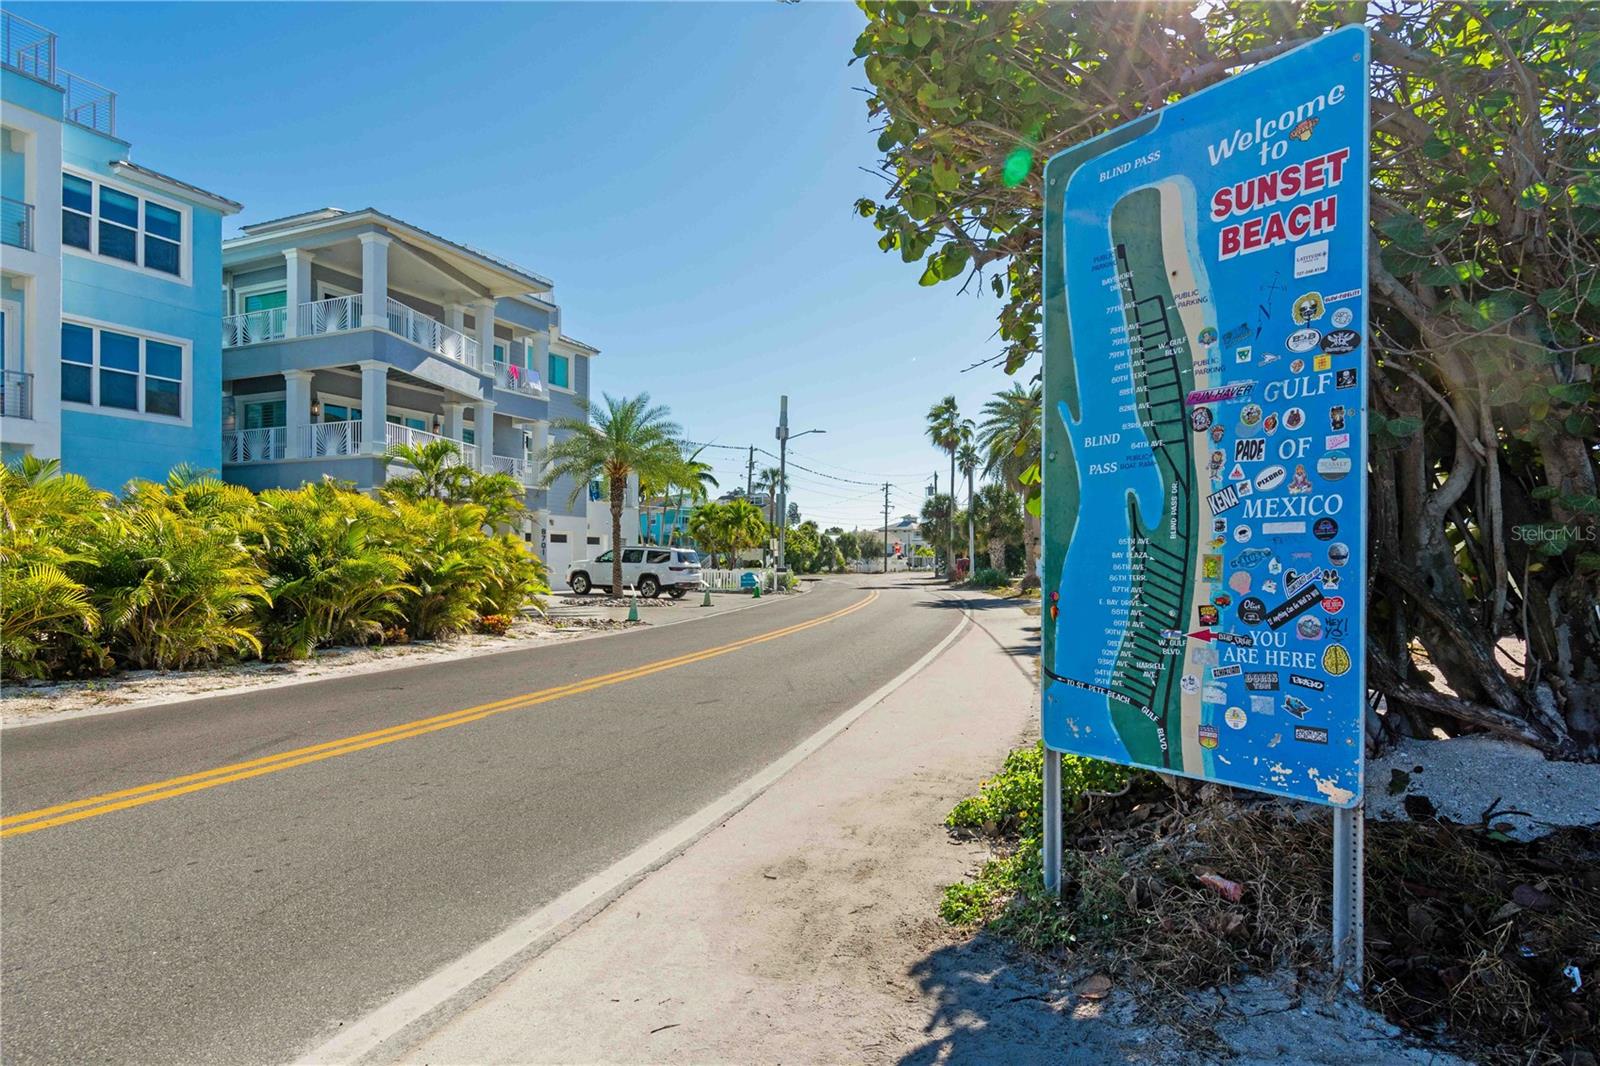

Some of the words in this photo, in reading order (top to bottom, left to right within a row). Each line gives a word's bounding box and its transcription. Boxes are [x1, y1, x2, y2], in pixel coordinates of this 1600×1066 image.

[1208, 84, 1345, 167] Welcome
[1258, 138, 1288, 166] to
[1099, 162, 1132, 183] BLIND
[1134, 150, 1161, 169] PASS
[1211, 148, 1350, 222] SUNSET
[1219, 195, 1337, 262] BEACH
[1174, 289, 1199, 300] PUBLIC
[1177, 296, 1208, 308] PARKING
[1106, 304, 1124, 314] 77TH
[1158, 342, 1168, 350] W.
[1169, 336, 1187, 347] GULF
[1193, 358, 1221, 367] PUBLIC
[1194, 366, 1226, 376] PARKING
[1264, 372, 1333, 403] GULF
[1142, 420, 1157, 428] AVE.
[1084, 433, 1121, 448] BLIND
[1150, 440, 1165, 448] AVE.
[1279, 437, 1313, 460] OF
[1089, 462, 1118, 475] PASS
[1171, 481, 1179, 494] DR.
[1208, 487, 1239, 515] KENA
[1242, 494, 1343, 518] MEXICO
[1170, 517, 1178, 539] BLIND
[1120, 599, 1140, 607] DRIVE
[1123, 641, 1137, 649] AVE.
[1169, 639, 1188, 647] GULF
[1250, 631, 1287, 648] YOU
[1120, 650, 1134, 658] AVE.
[1162, 648, 1182, 656] BLVD.
[1223, 647, 1259, 664] ARE
[1265, 650, 1317, 670] HERE
[1116, 660, 1130, 668] AVE.
[1112, 670, 1126, 678] AVE.
[1111, 679, 1125, 687] AVE.
[1076, 681, 1087, 690] ST.
[1088, 684, 1106, 695] PETE
[1107, 690, 1131, 705] BEACH
[1141, 706, 1160, 722] GULF
[1157, 728, 1168, 752] BLVD.
